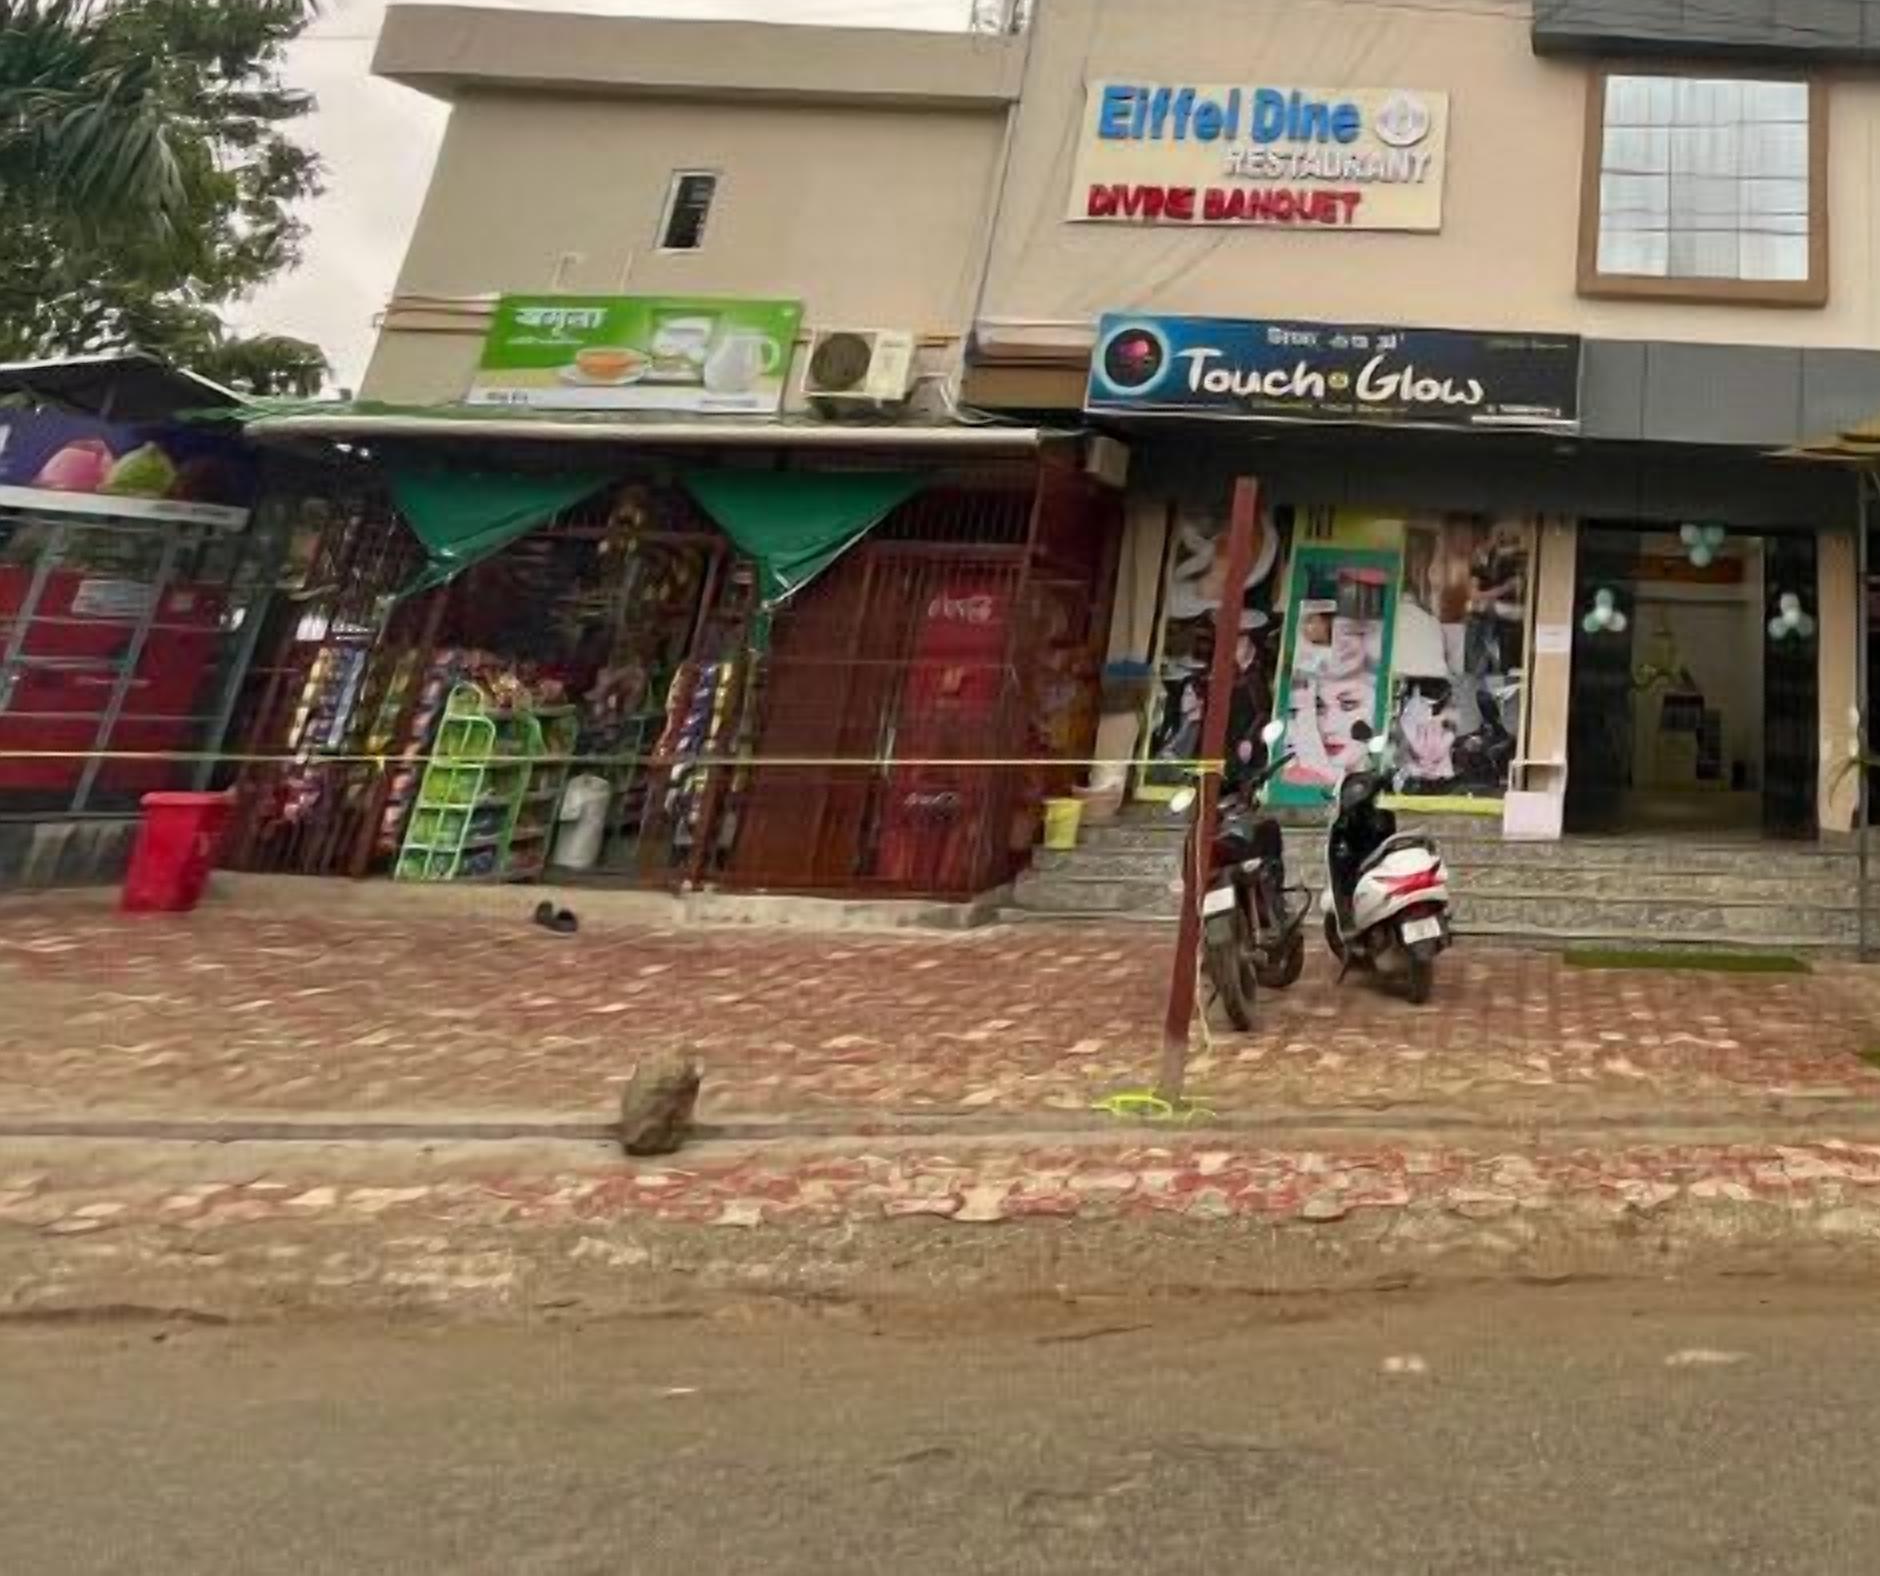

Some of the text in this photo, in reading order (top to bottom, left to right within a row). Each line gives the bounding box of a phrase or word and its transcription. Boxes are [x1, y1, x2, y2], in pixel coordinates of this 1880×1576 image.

[1096, 84, 1361, 144] Eiffel Dine
[1224, 147, 1432, 184] RESTAURANT
[1203, 188, 1362, 224] BANQUET
[1172, 347, 1485, 404] Touch Glow
